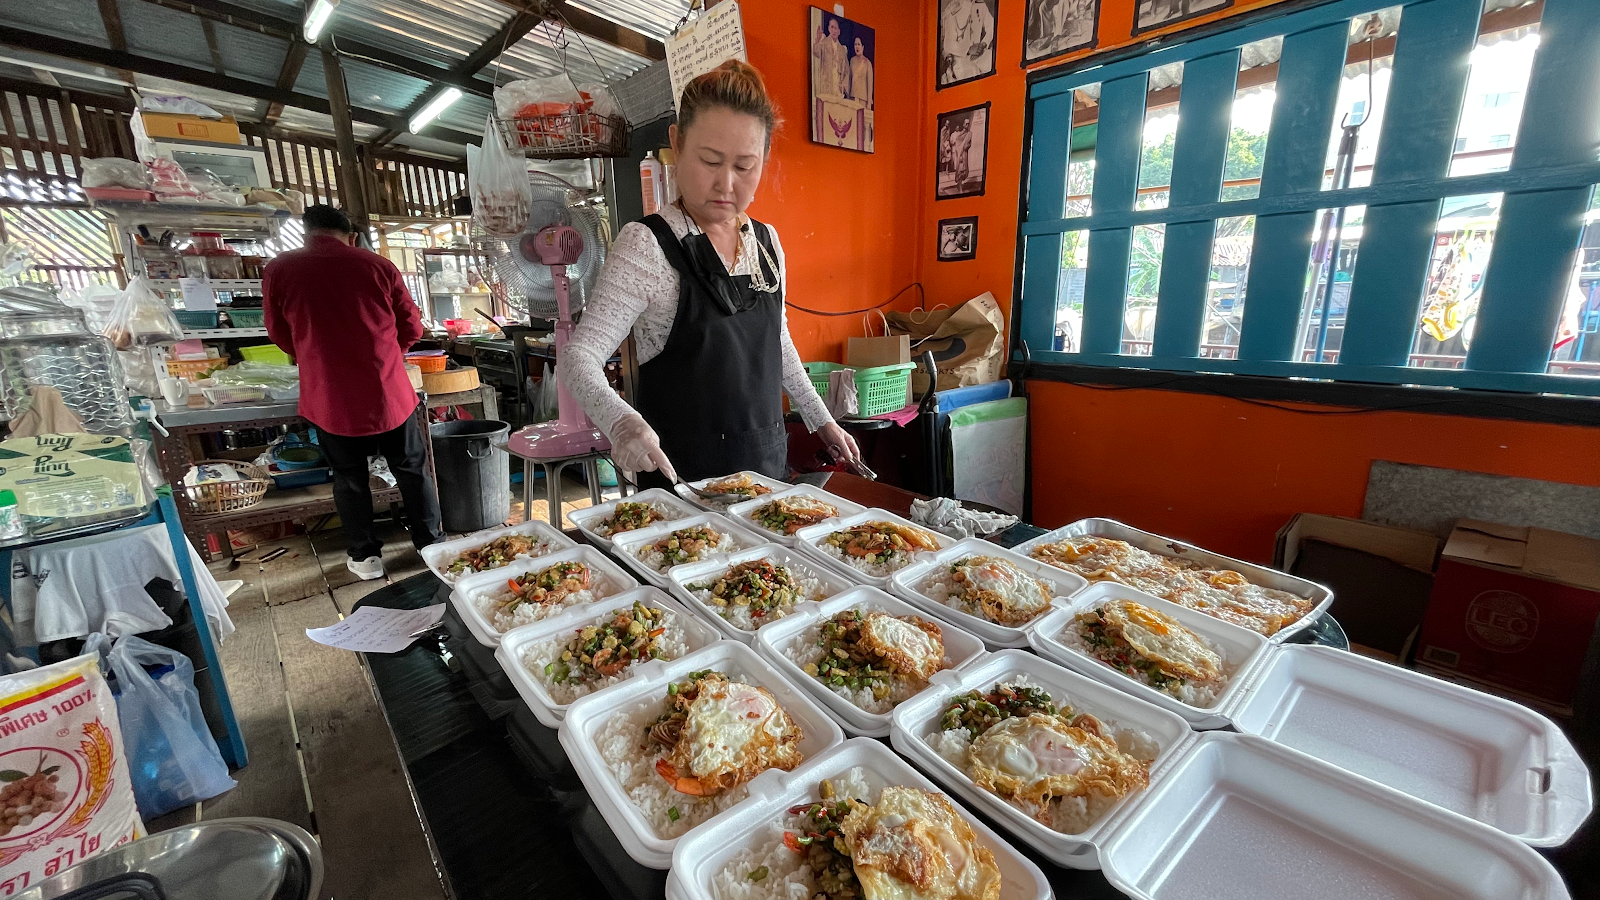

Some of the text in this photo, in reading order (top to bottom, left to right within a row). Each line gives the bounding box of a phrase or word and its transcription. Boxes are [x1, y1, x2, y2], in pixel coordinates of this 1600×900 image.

[1471, 606, 1528, 632] LEO
[0, 689, 97, 739] พิเศษ 100%
[45, 832, 101, 877] ลำไย
